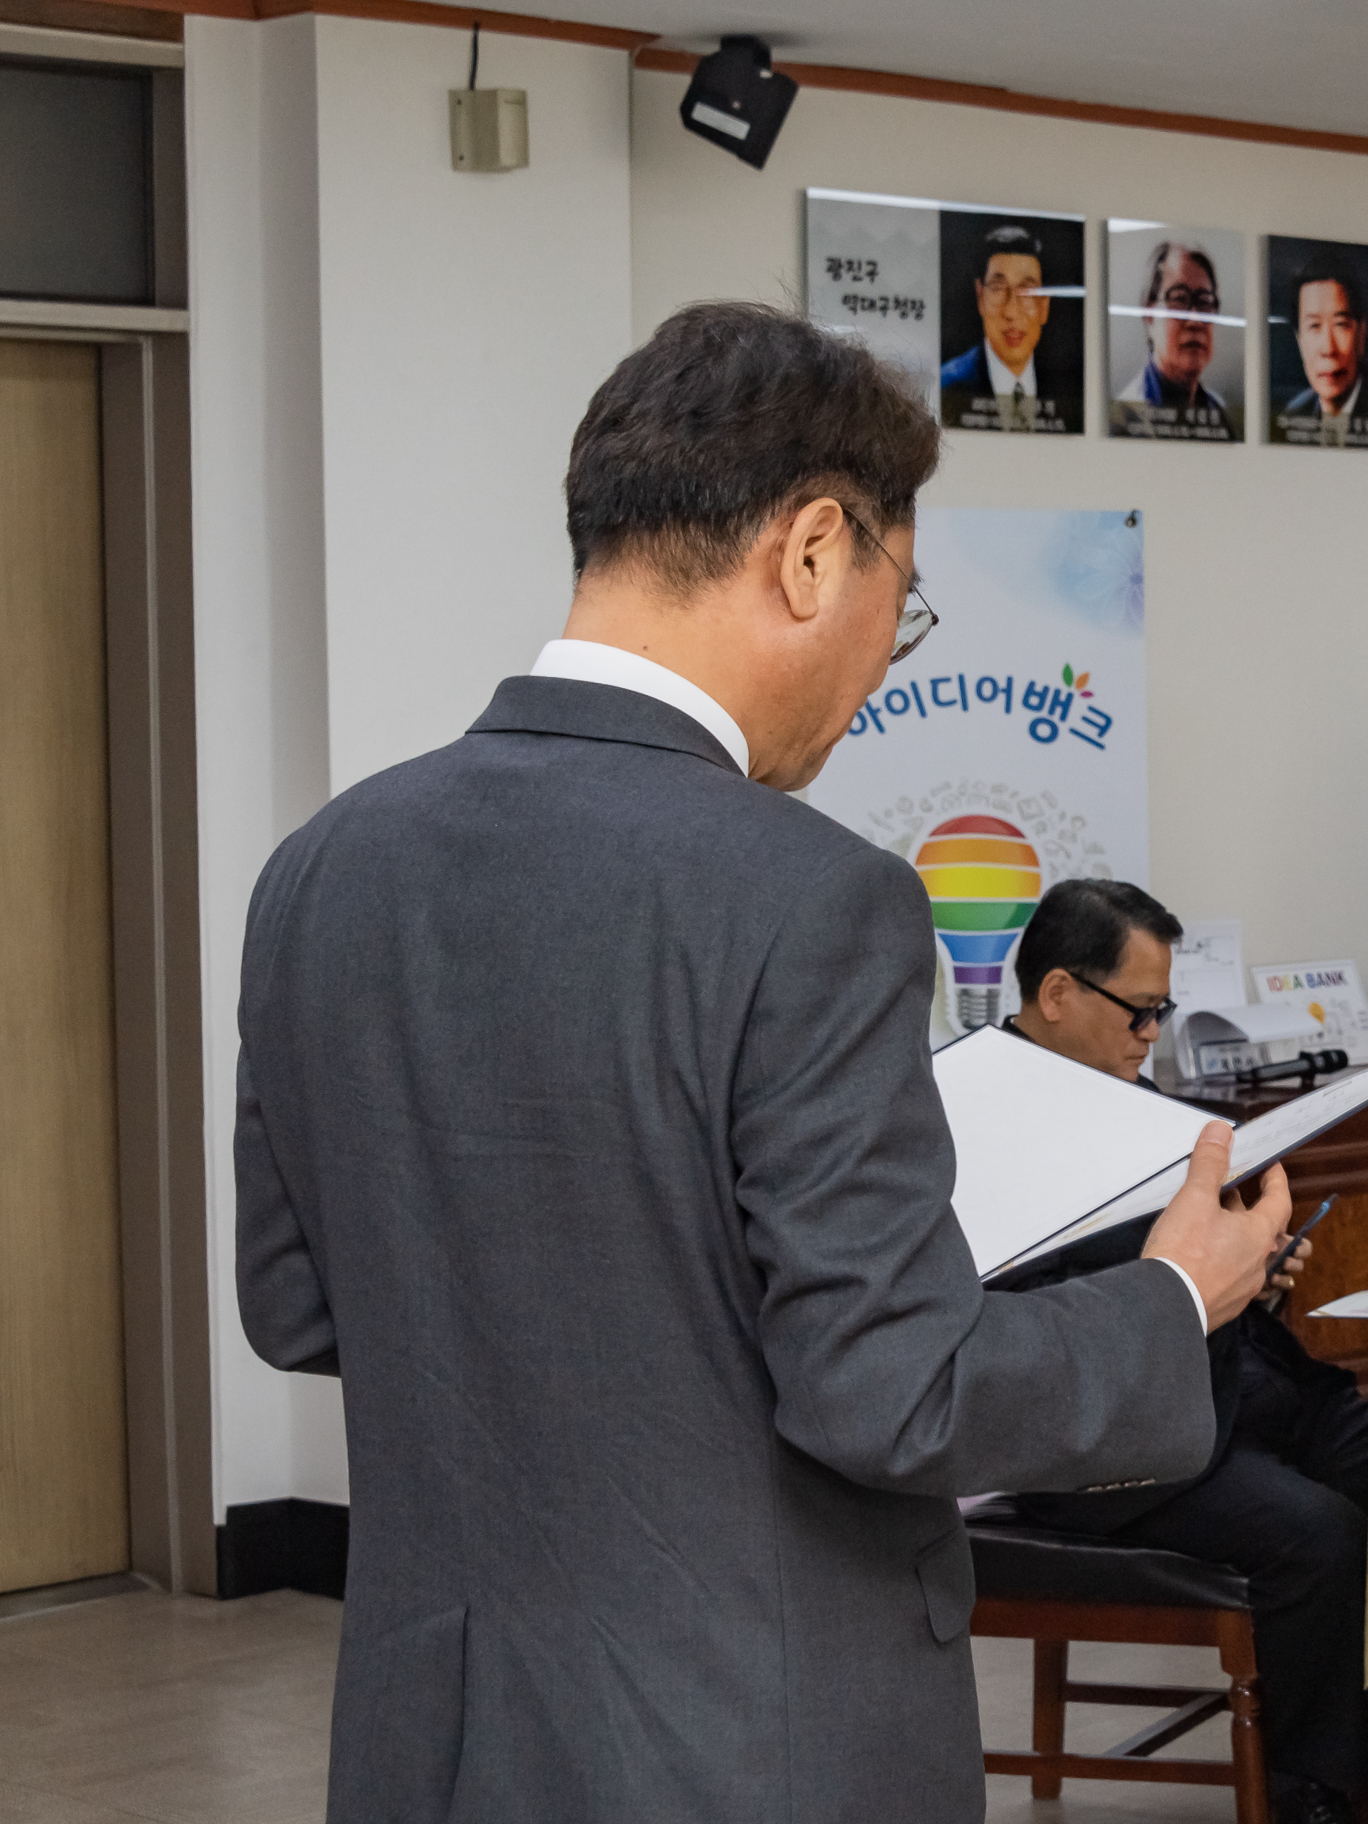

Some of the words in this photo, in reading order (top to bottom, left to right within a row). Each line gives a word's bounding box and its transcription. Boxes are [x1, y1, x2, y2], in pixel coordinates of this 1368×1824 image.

[826, 256, 879, 284] 광진구
[842, 293, 925, 321] 역대구청장
[848, 673, 1113, 750] 아이디어뱅크
[1267, 973, 1304, 993] IDEA
[1305, 970, 1347, 989] BANK
